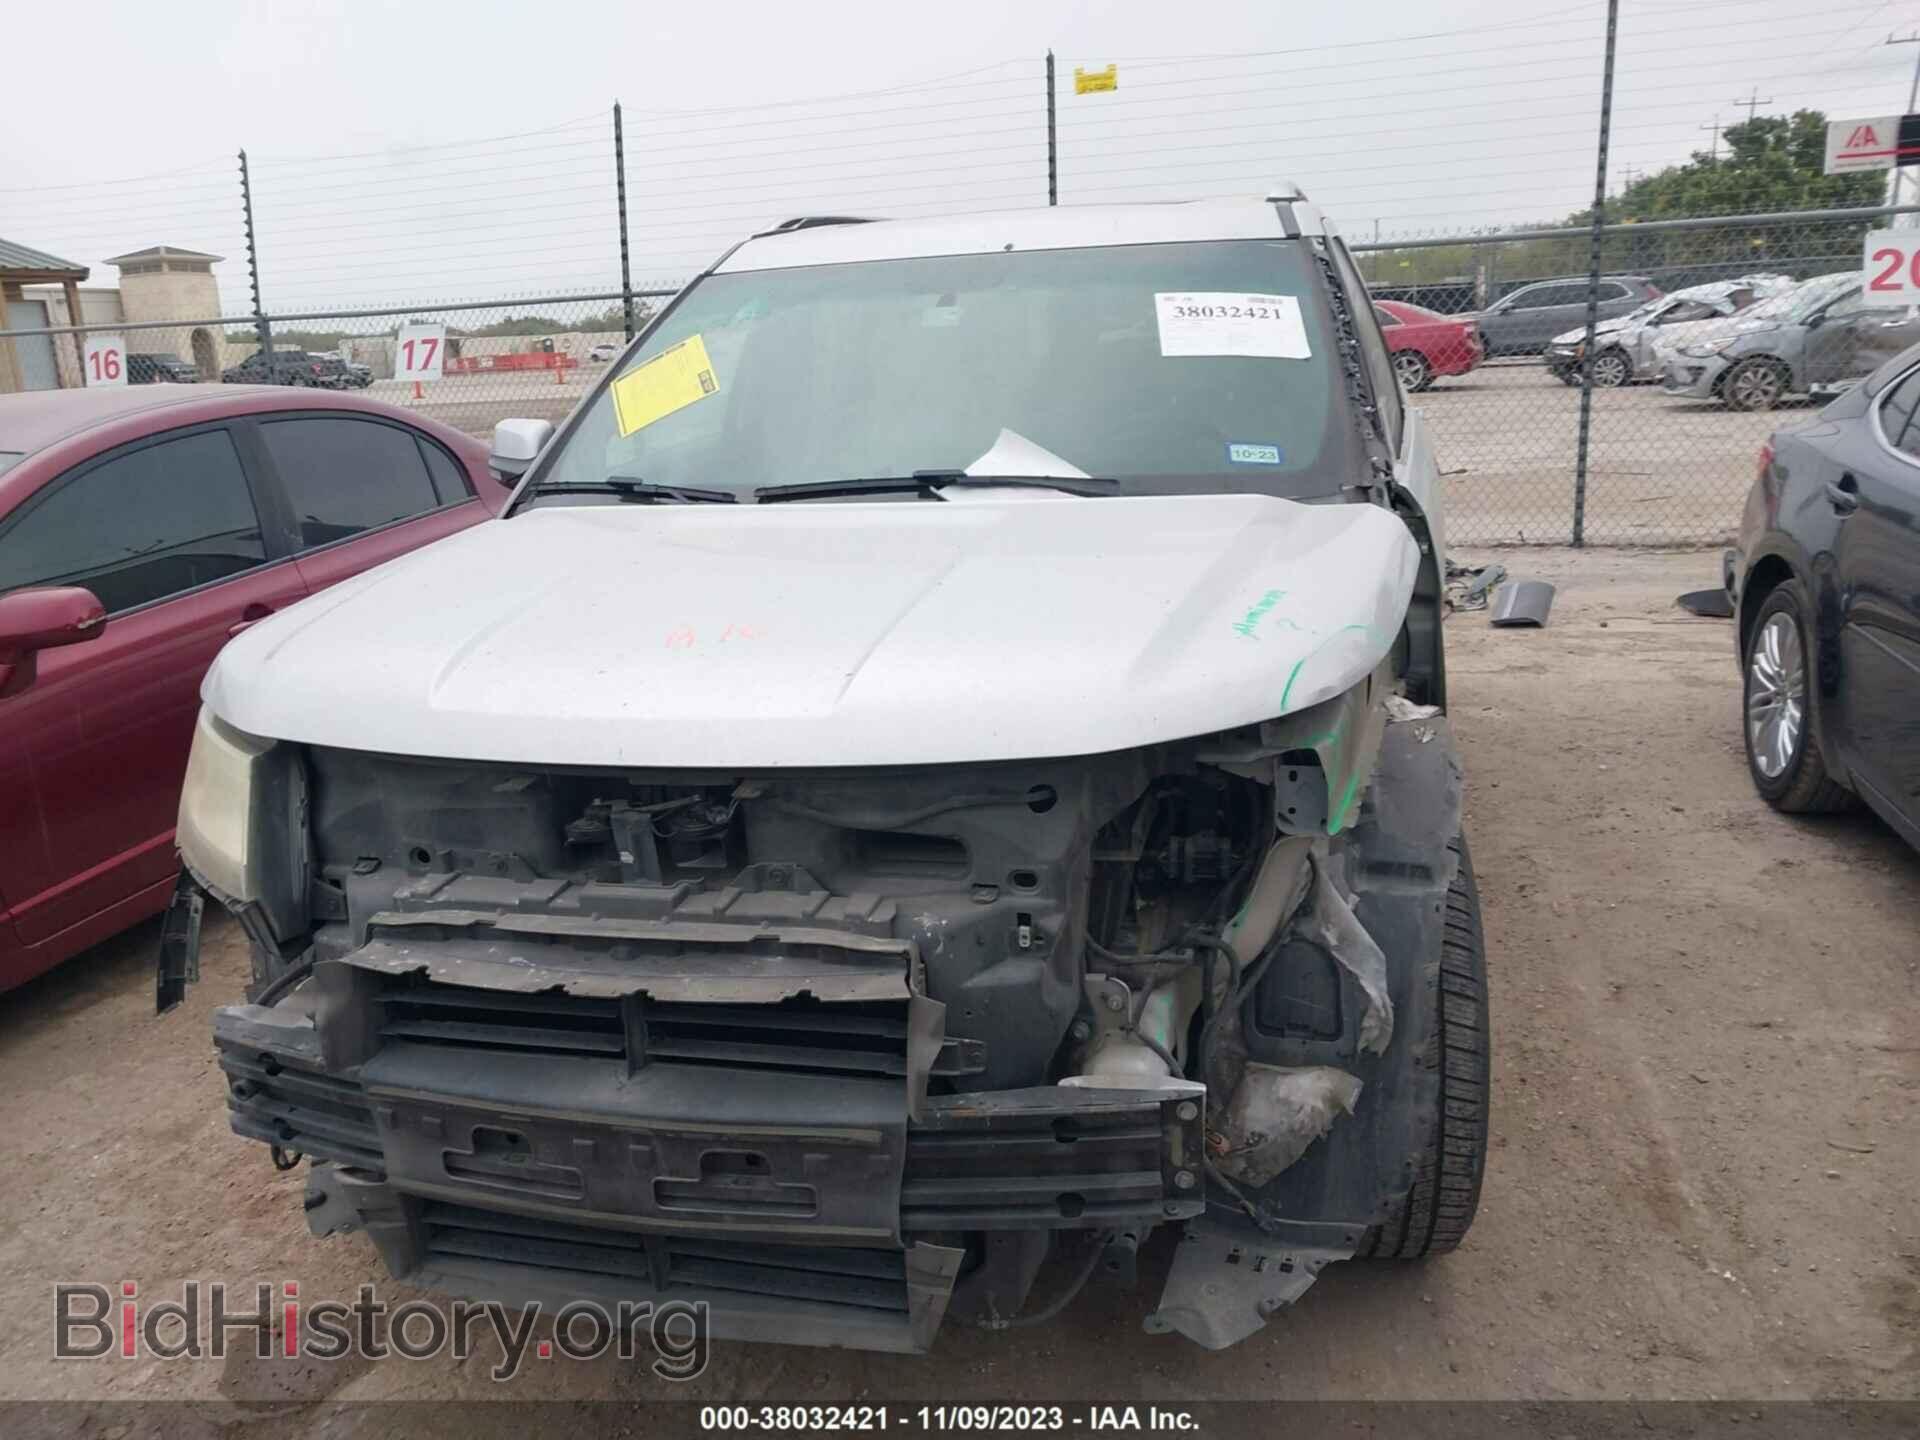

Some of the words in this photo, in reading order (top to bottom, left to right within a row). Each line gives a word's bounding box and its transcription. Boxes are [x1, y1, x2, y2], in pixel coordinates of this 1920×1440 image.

[1173, 304, 1283, 321] 38032421
[89, 348, 121, 381] 16
[402, 337, 439, 371] 17
